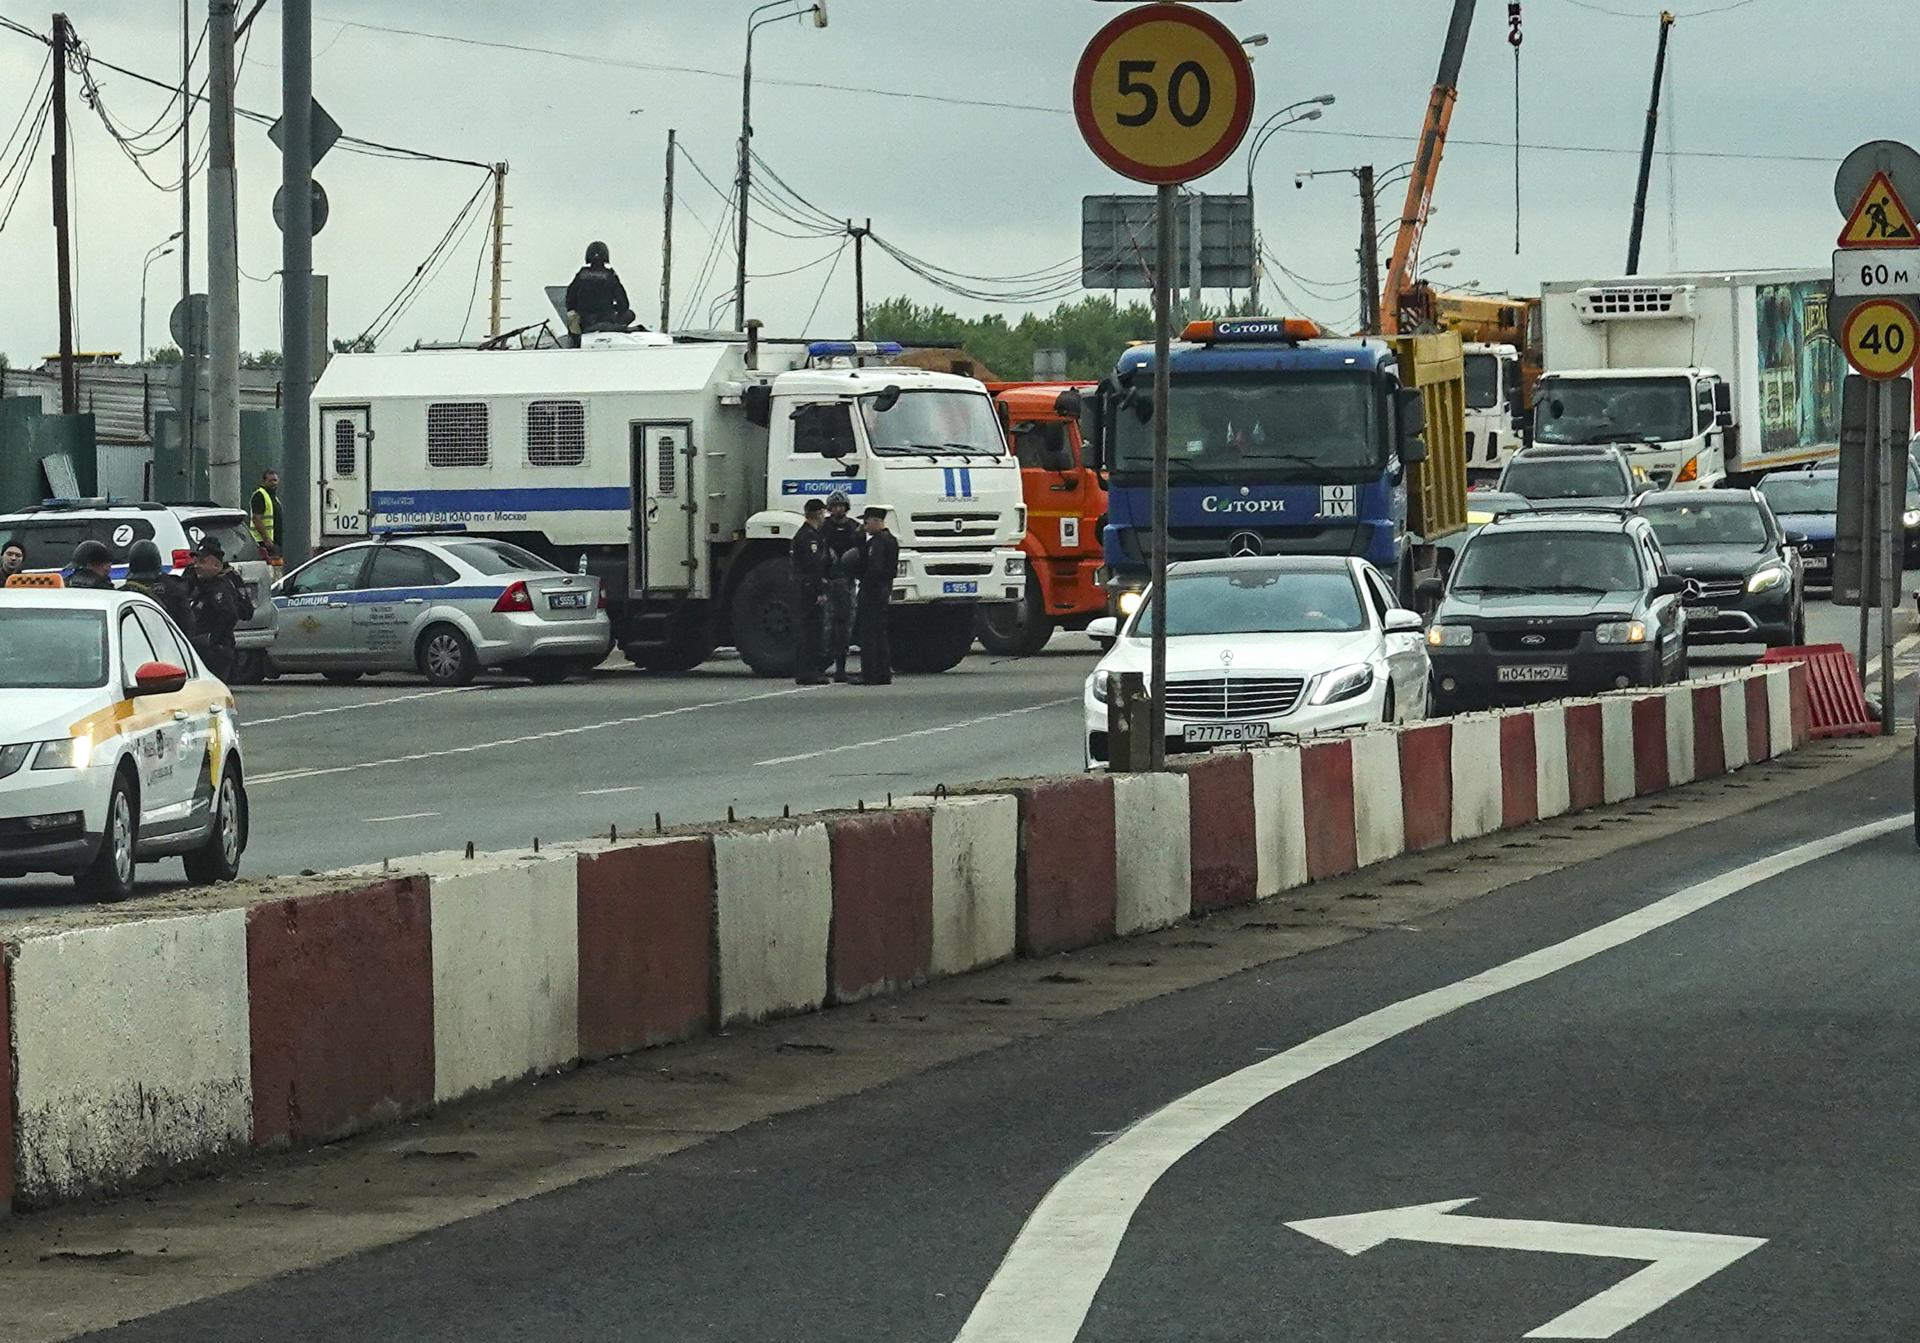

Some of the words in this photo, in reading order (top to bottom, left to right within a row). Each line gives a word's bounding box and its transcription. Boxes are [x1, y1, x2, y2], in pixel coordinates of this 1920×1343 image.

[1115, 60, 1212, 128] 50
[1860, 264, 1888, 287] 60
[1894, 269, 1909, 283] м
[1858, 323, 1905, 355] 40
[804, 482, 852, 492] ПОЛИЦИЯ
[333, 515, 359, 530] 102
[428, 511, 447, 522] УВД
[449, 511, 472, 522] ЮАО
[116, 528, 129, 543] Z
[287, 595, 329, 607] ПОЛИЦИЯ
[1244, 724, 1264, 736] 177
